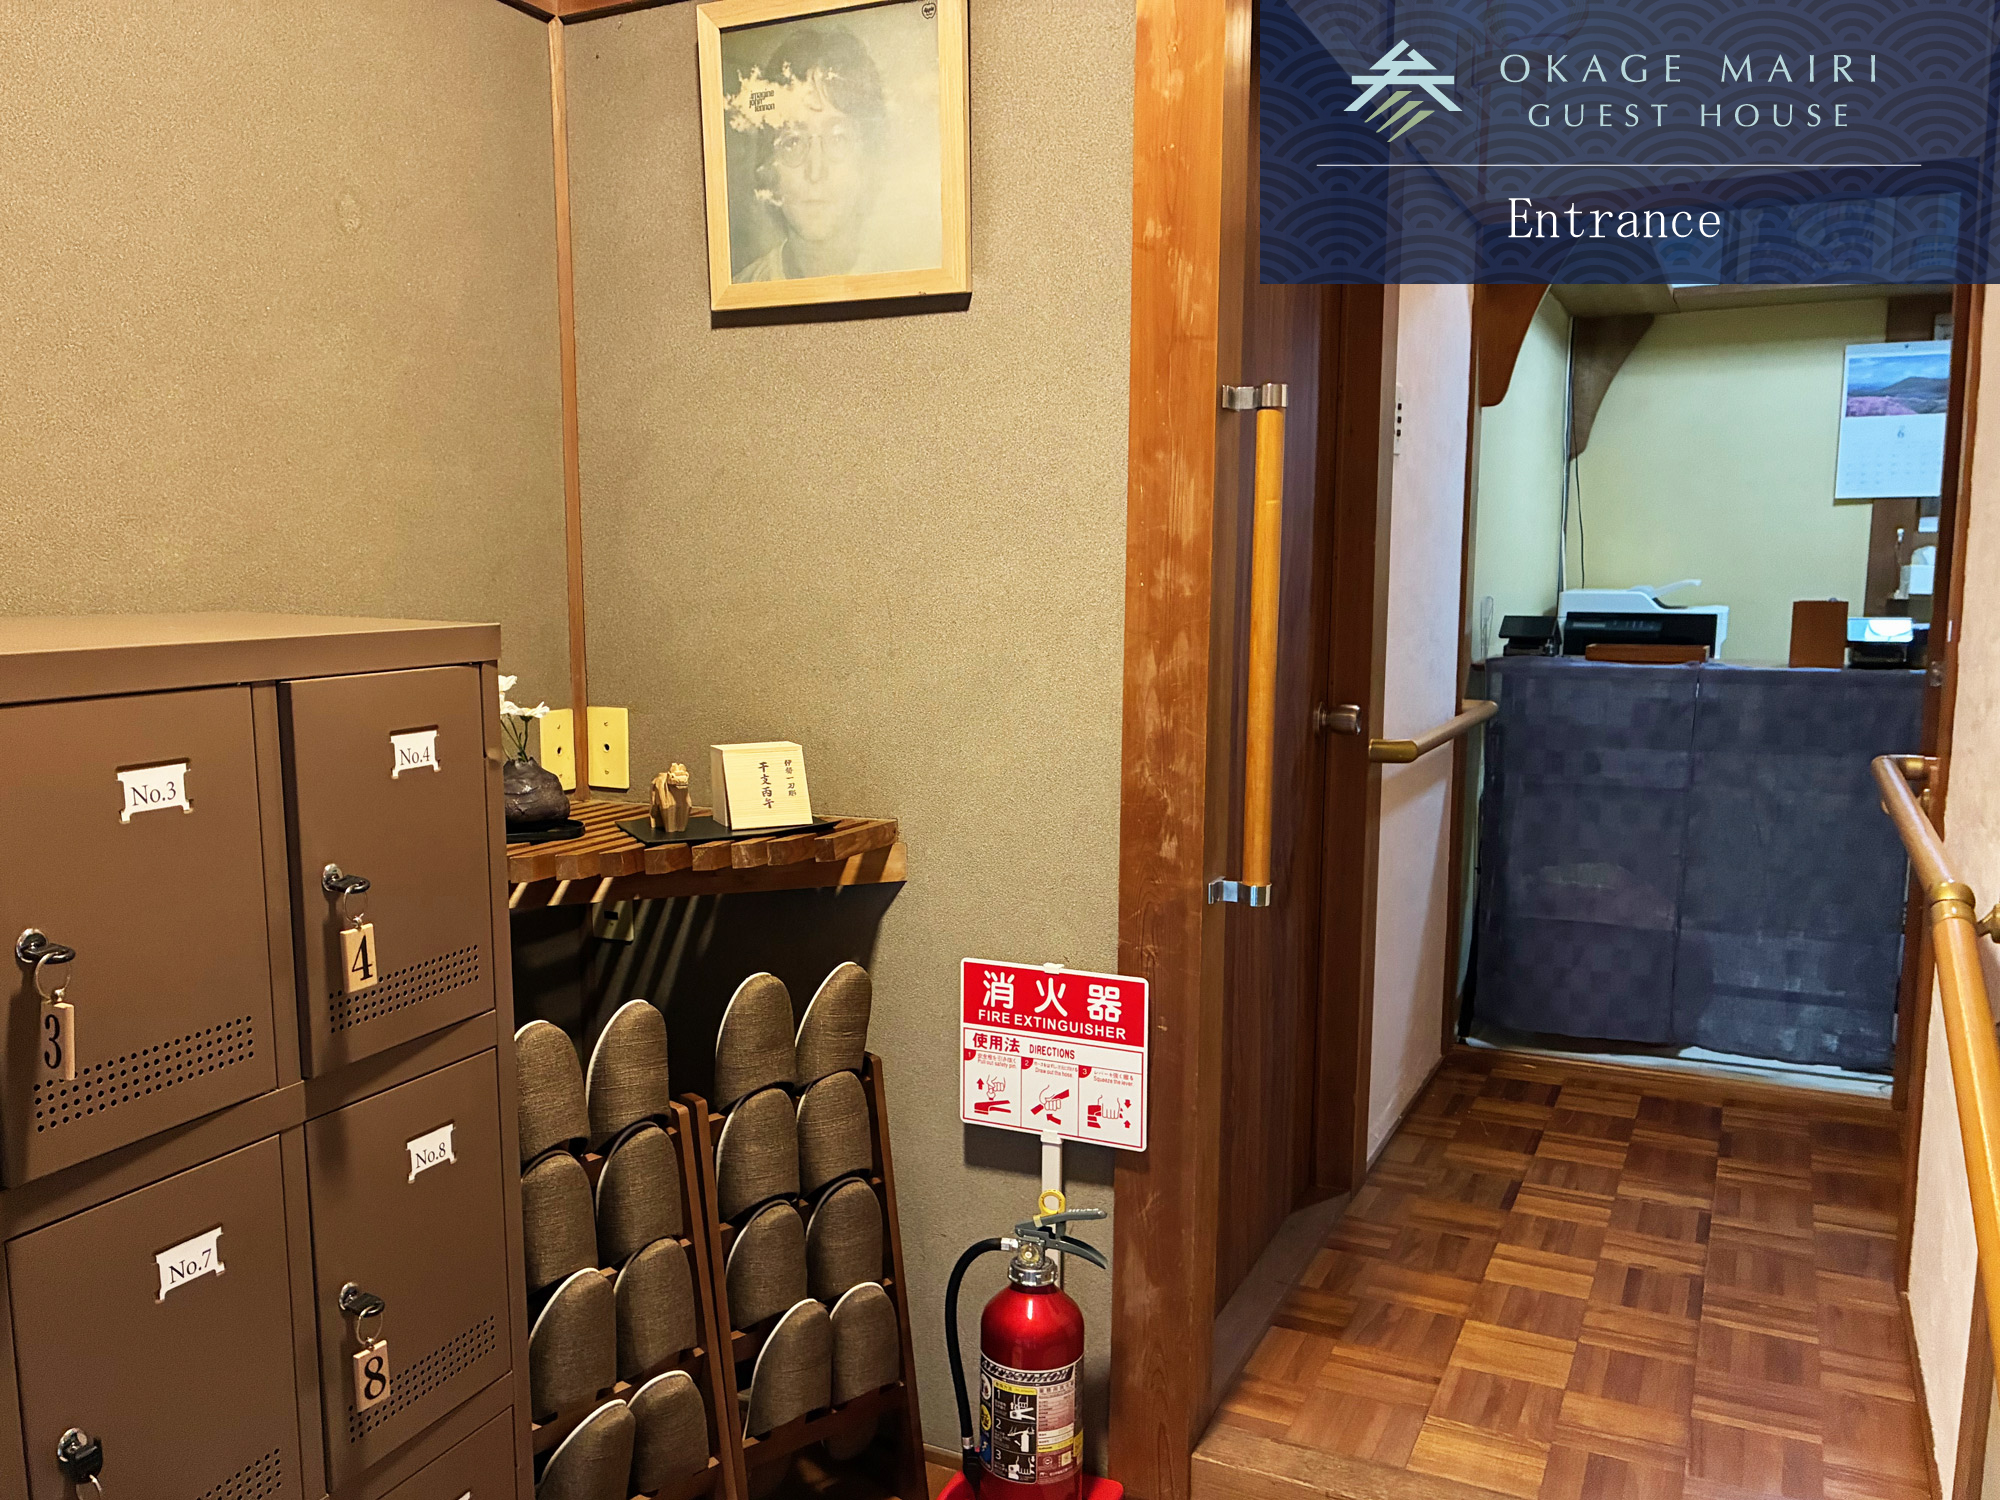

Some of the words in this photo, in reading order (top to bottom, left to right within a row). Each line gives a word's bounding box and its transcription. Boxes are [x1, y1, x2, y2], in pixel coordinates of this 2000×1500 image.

[750, 88, 775, 100] imagine
[755, 103, 775, 112] lennon
[1897, 429, 1904, 438] 6
[399, 746, 430, 765] No.4
[131, 781, 176, 806] No.3
[351, 934, 374, 982] 4
[982, 970, 1122, 1023] 消火器
[978, 1009, 1010, 1024] FIRE
[1014, 1013, 1126, 1040] EXTINGUISHER
[43, 1013, 62, 1070] 3
[973, 1032, 1020, 1053] 使用法
[1029, 1044, 1075, 1060] DIRECTIONS
[416, 1142, 446, 1168] No.8
[168, 1248, 211, 1284] No.7
[363, 1355, 387, 1400] 8
[995, 1418, 1001, 1429] 2
[995, 1449, 1001, 1460] 3
